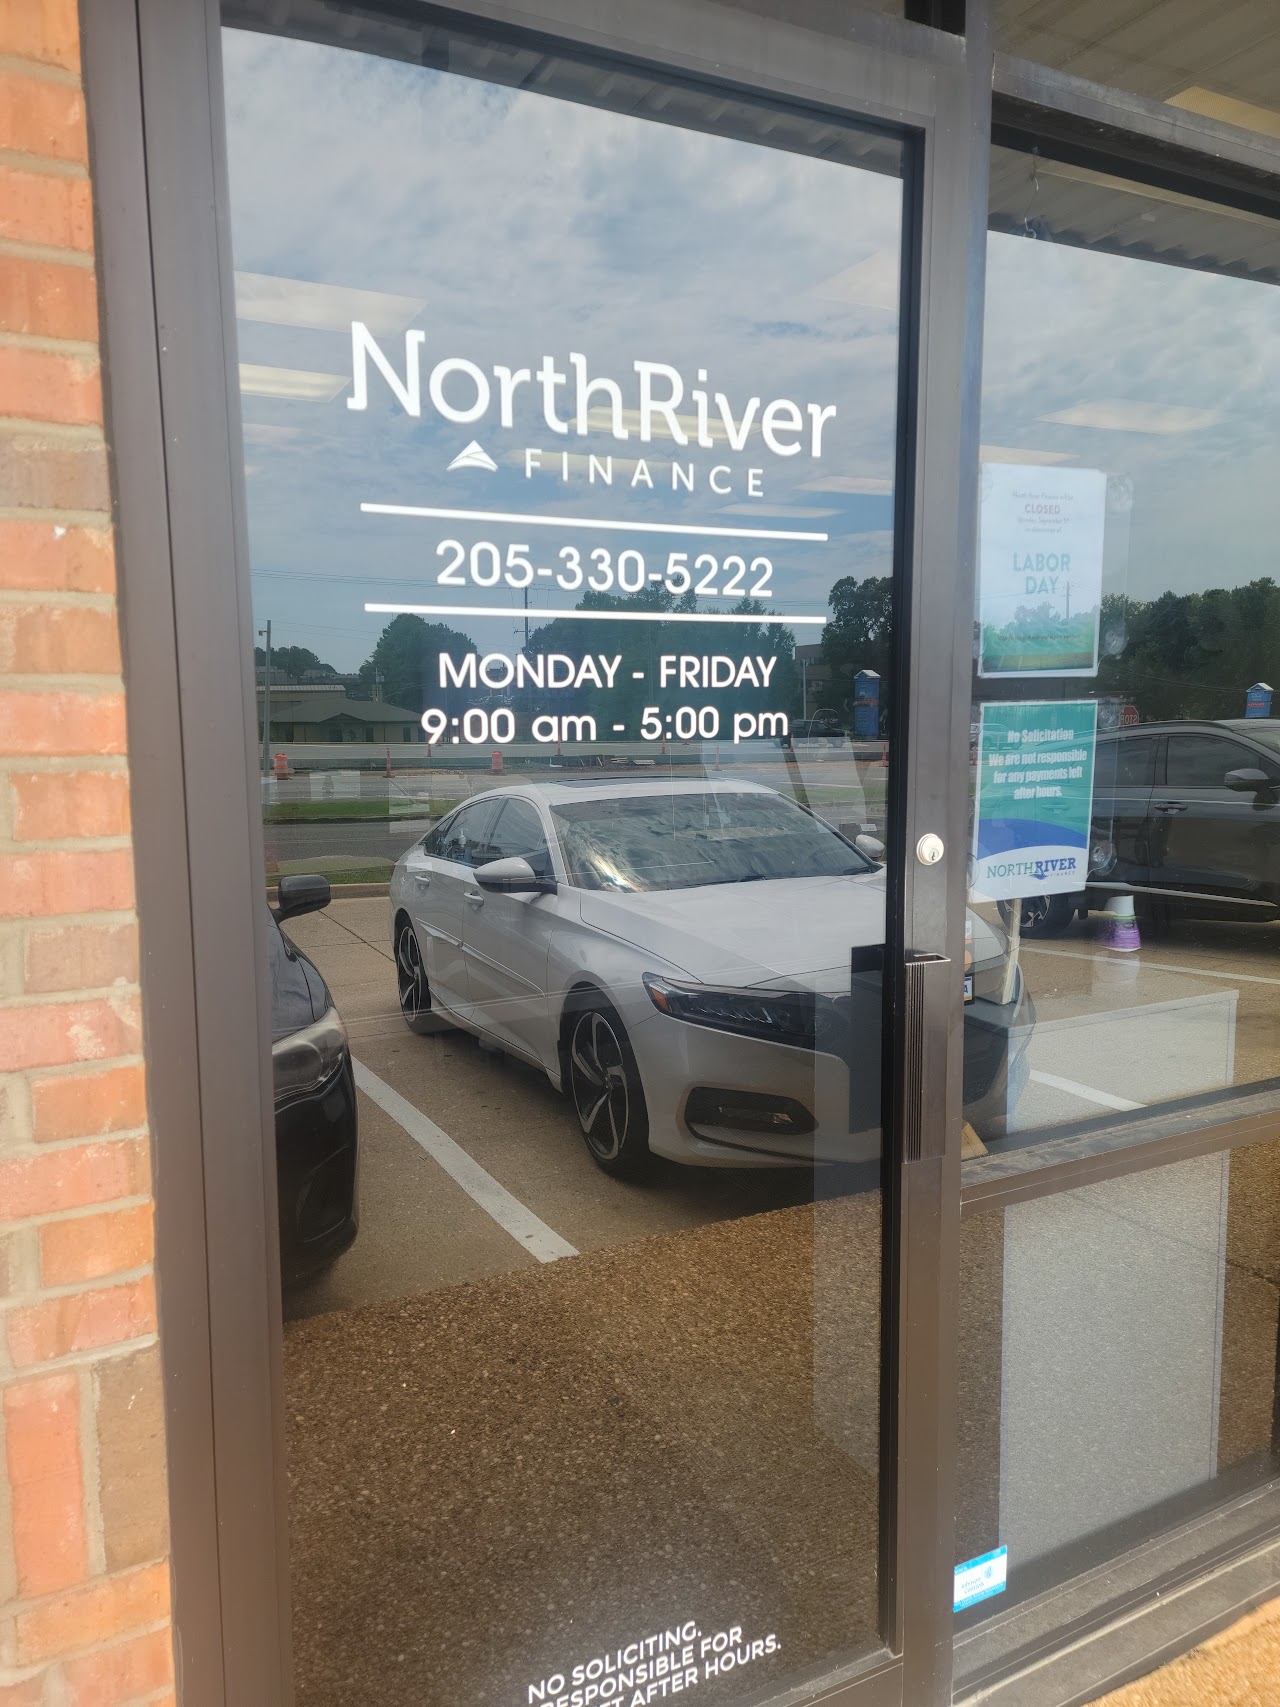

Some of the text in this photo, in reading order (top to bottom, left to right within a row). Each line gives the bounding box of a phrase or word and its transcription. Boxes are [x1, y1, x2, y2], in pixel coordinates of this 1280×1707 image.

[347, 321, 838, 458] NorthRiver
[525, 447, 764, 497] FINANCE
[1025, 503, 1061, 515] CLOSED
[436, 539, 774, 598] 205-330-5222
[1013, 552, 1071, 572] LABOR
[1025, 576, 1059, 595] DAY
[439, 652, 622, 689] MONDAY
[660, 655, 777, 688] FRIDAY
[421, 708, 515, 744] 9:00
[531, 714, 597, 742] am
[640, 706, 719, 740] 5:00
[733, 711, 789, 744] pm
[1007, 728, 1074, 743] No Solicitation
[988, 749, 1087, 766] We are not responsible
[993, 766, 1082, 783] for any payments left
[1014, 786, 1062, 799] after hours.
[987, 858, 1076, 879] NORTHRIVER
[700, 1626, 743, 1658] FOR
[528, 1621, 701, 1704] NO SOLICITING.
[630, 1634, 781, 1707] AFTER HOURS.
